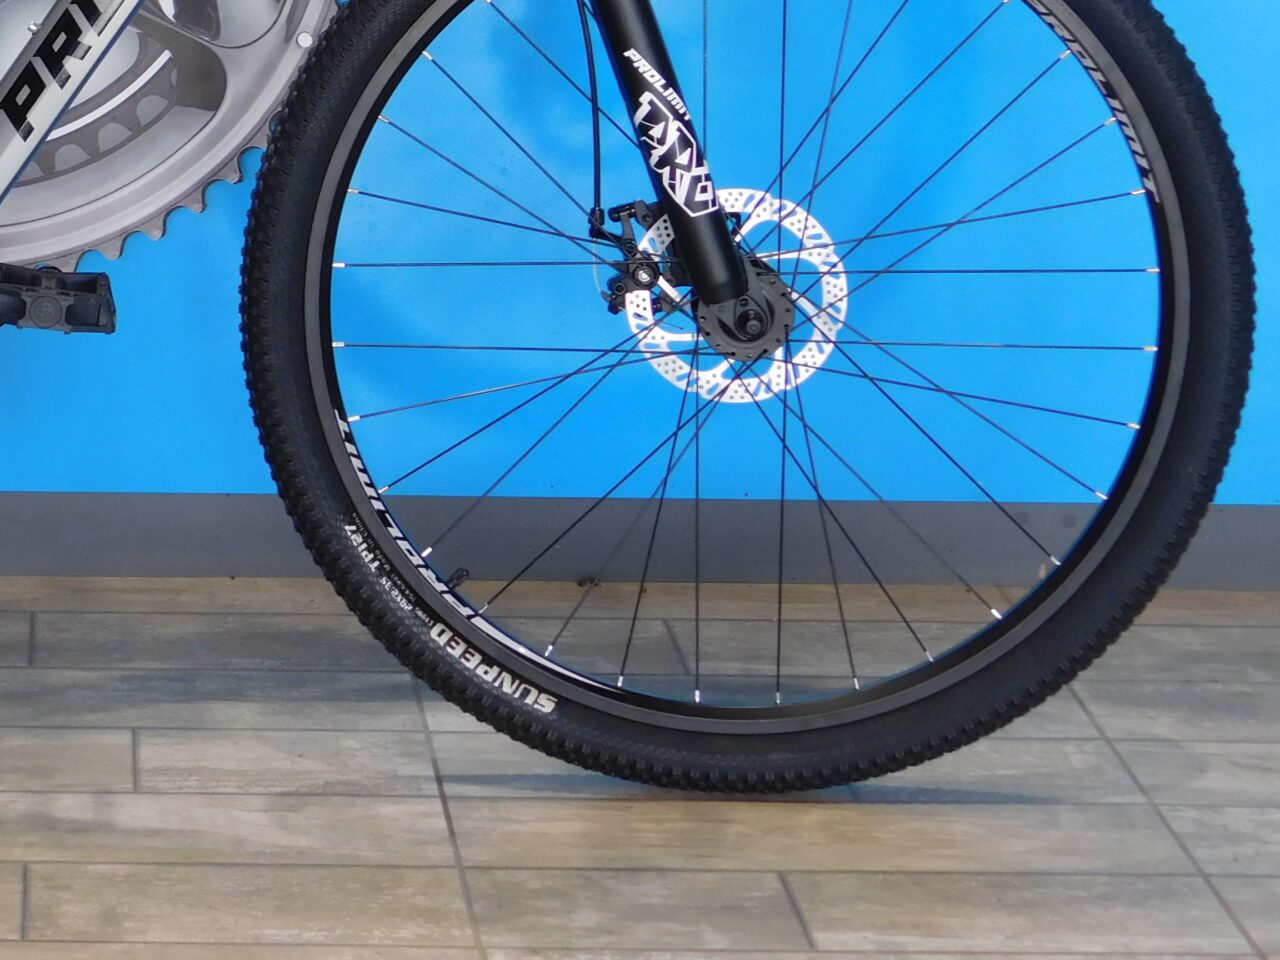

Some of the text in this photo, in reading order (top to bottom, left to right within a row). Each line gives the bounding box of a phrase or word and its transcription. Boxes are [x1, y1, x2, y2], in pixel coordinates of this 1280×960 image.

[623, 48, 692, 122] PROLIMIT
[334, 409, 476, 618] PROLIMIT
[429, 622, 559, 714] SUNPEED
